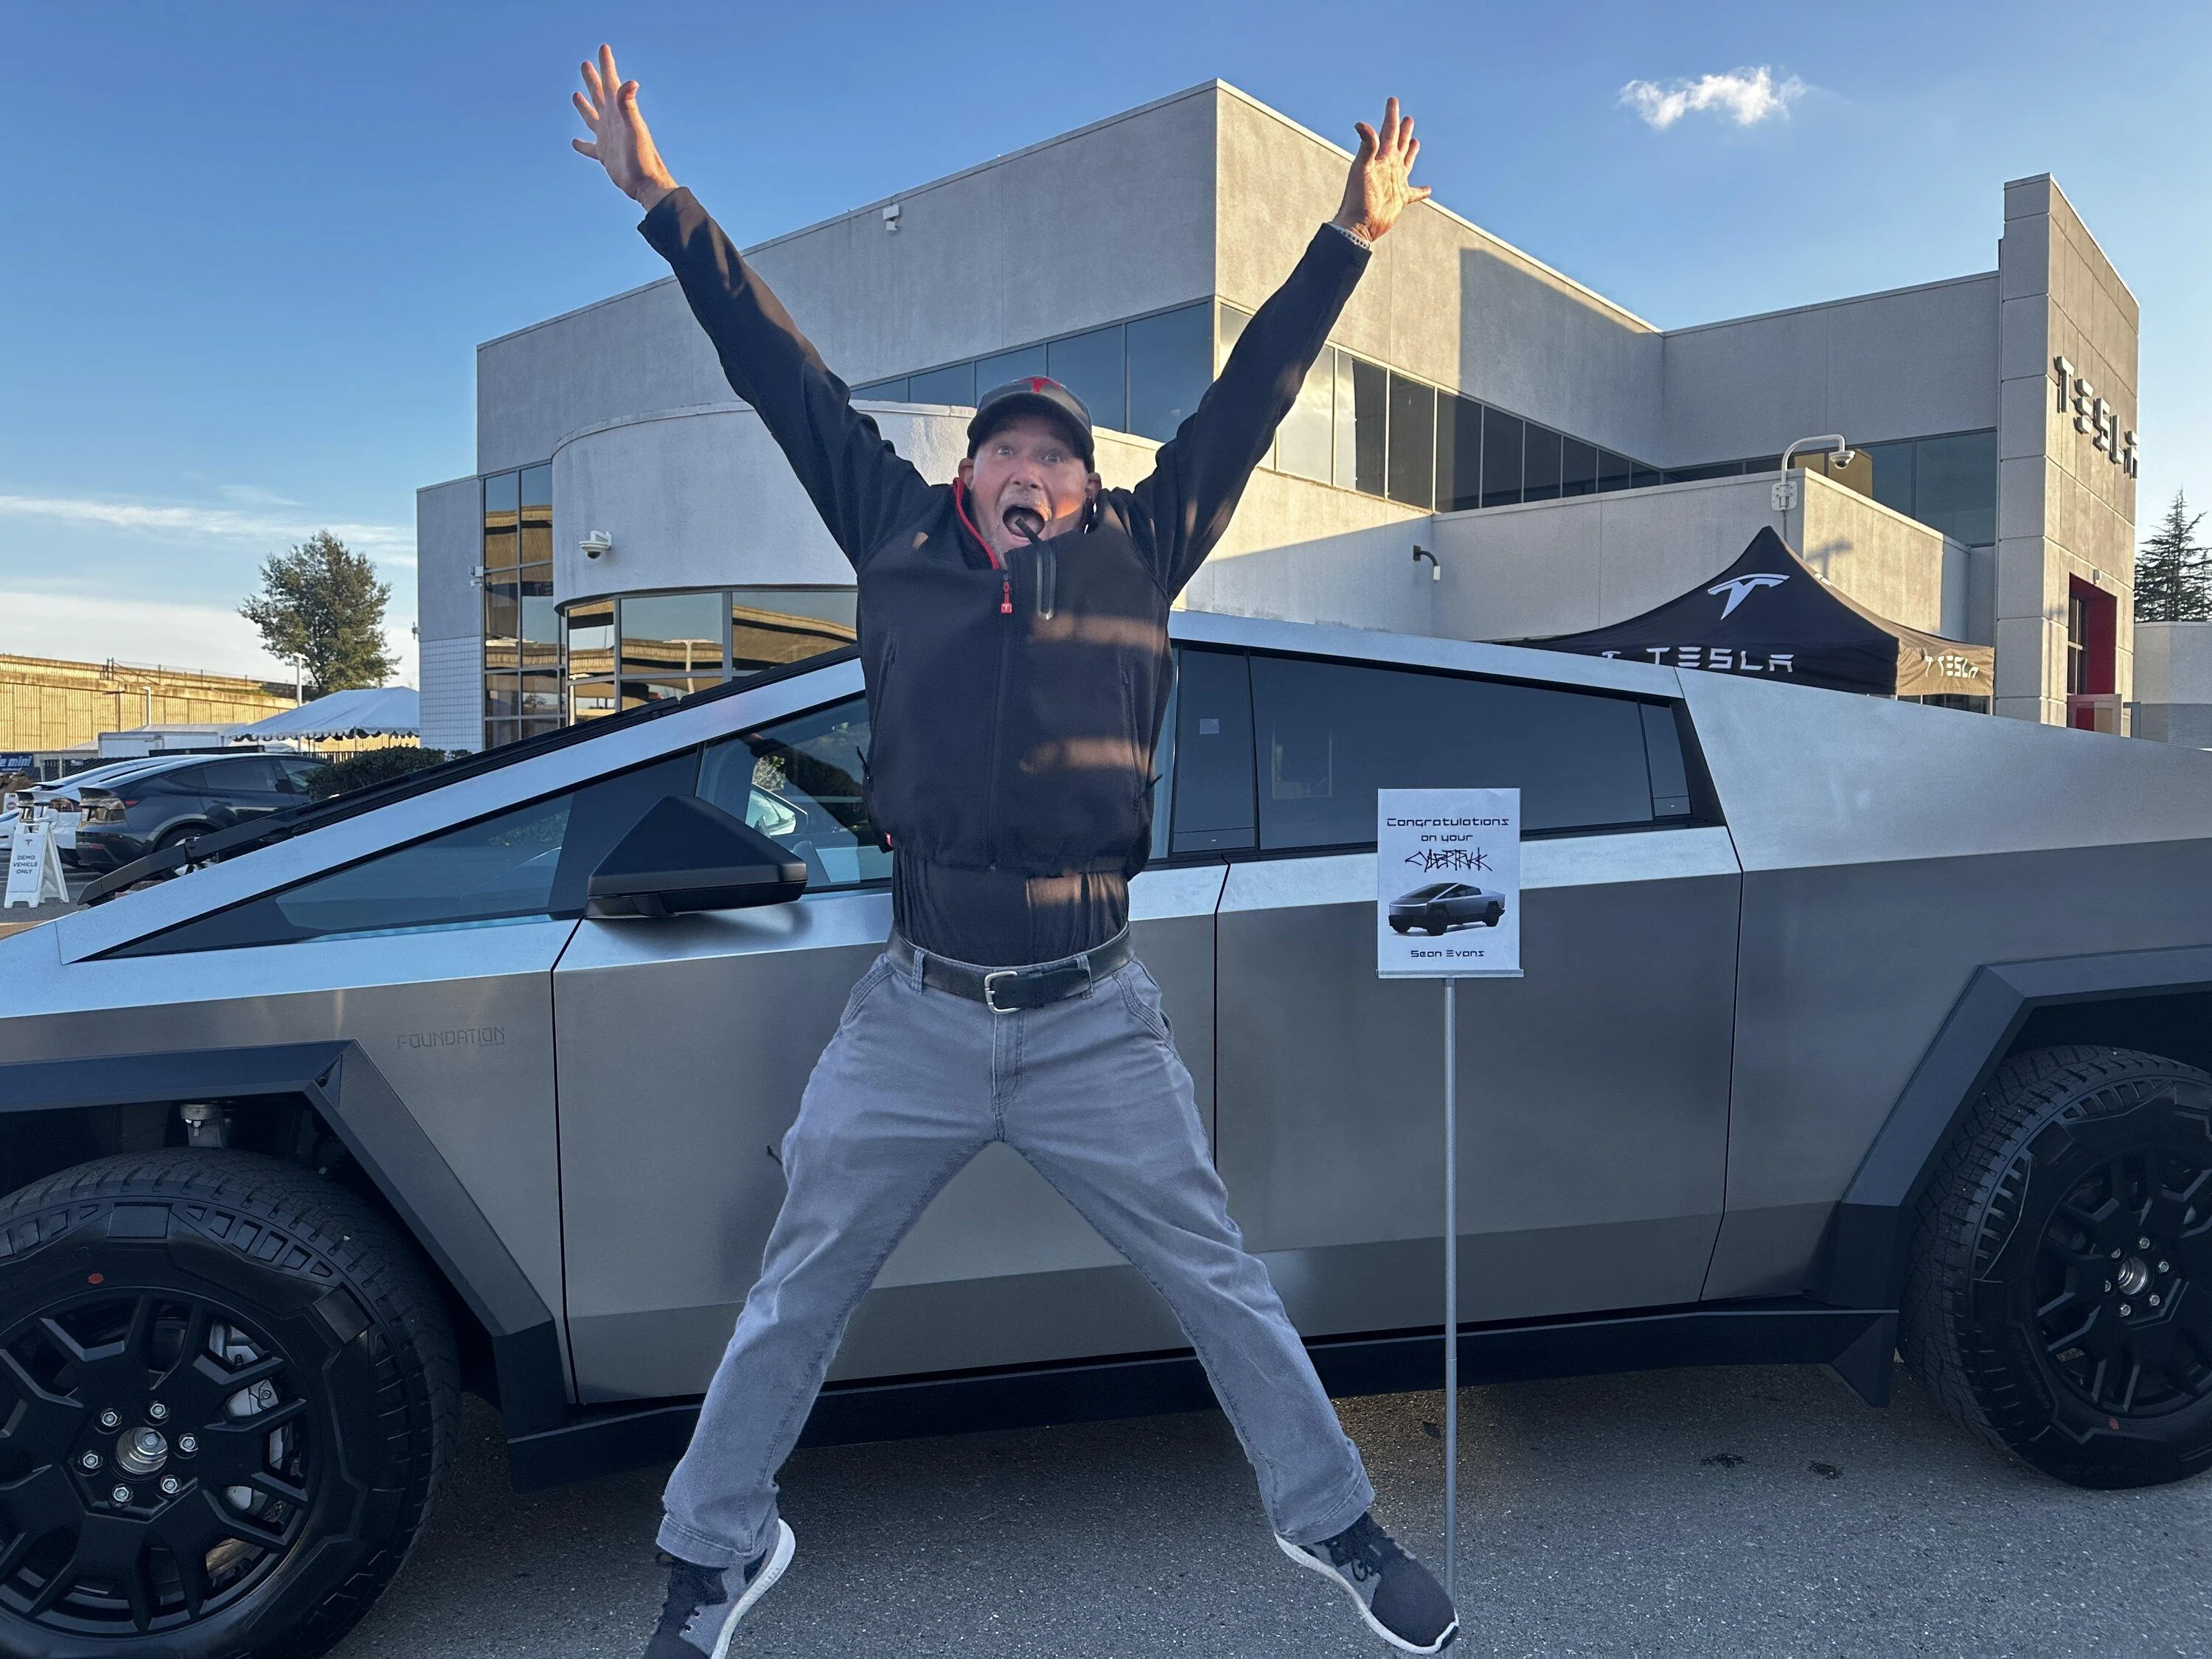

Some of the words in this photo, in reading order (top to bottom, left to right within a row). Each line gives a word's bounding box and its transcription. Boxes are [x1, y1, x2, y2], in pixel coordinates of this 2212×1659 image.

[2053, 355, 2138, 479] TESLA
[1646, 646, 1795, 673] TESLA
[1937, 655, 1979, 679] TESLA
[1387, 818, 1509, 827] Congratulations
[1411, 950, 1442, 958] Sean
[1446, 950, 1485, 958] Evans
[397, 1026, 506, 1049] FOUNDATION
